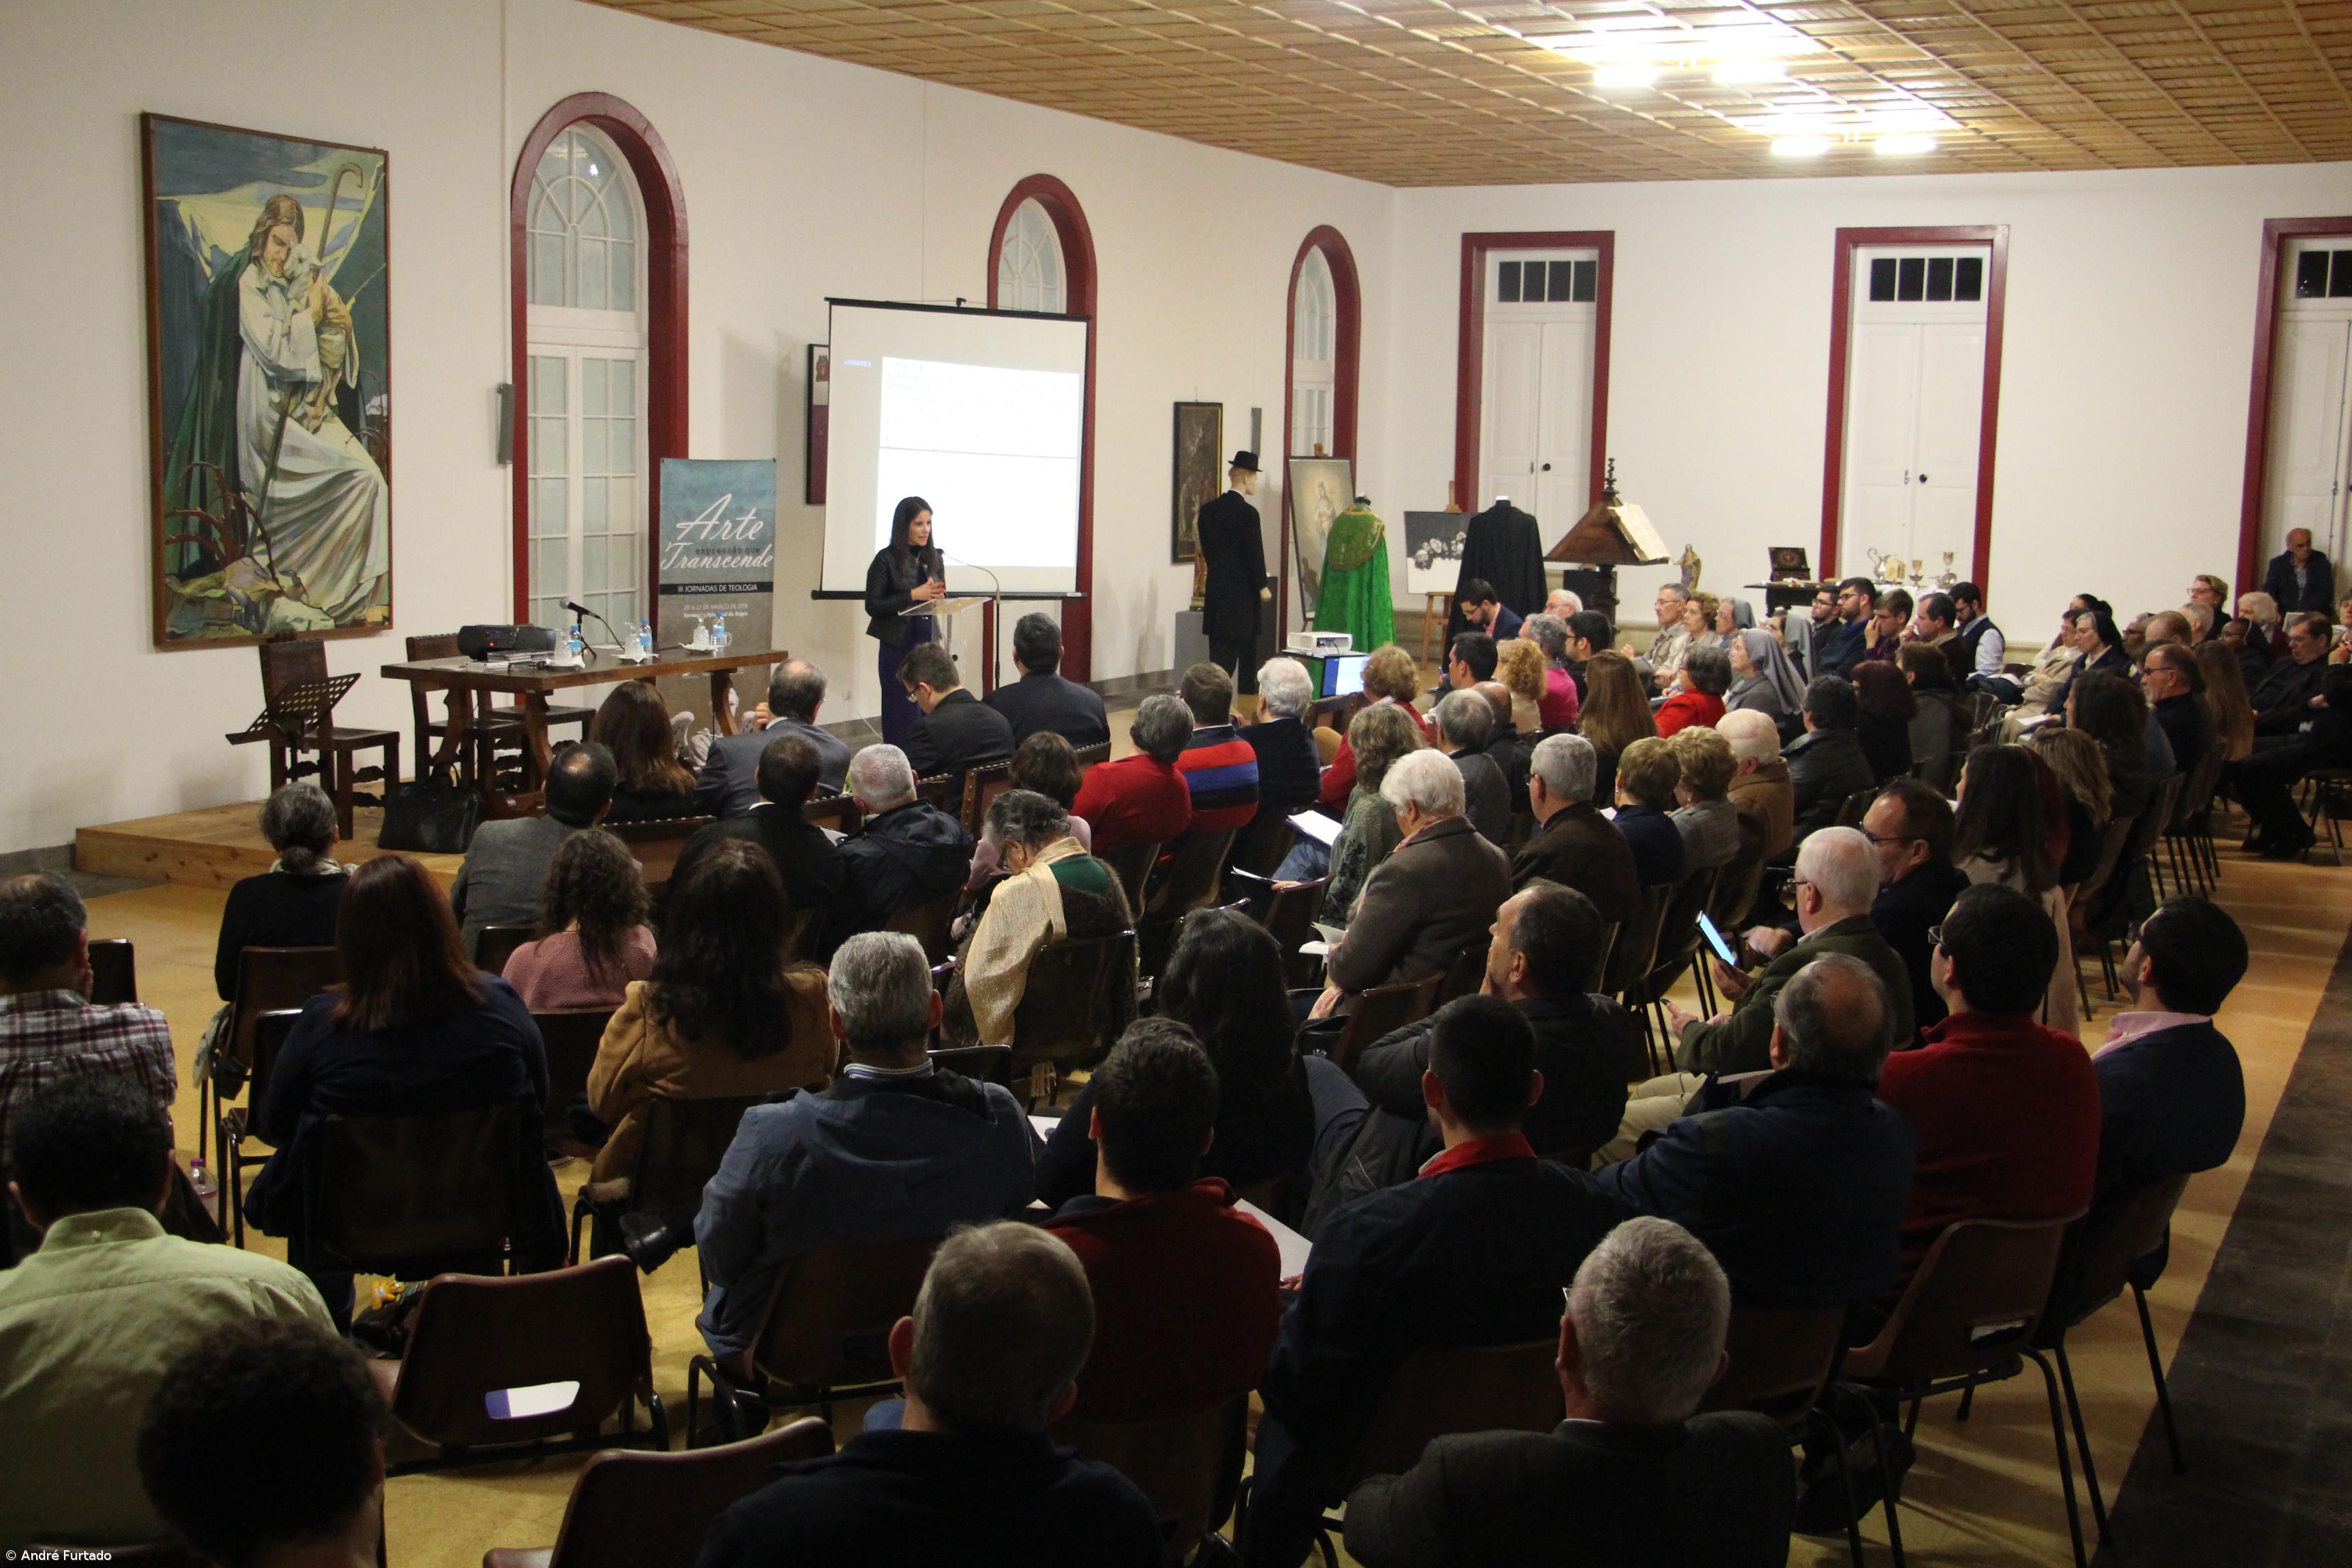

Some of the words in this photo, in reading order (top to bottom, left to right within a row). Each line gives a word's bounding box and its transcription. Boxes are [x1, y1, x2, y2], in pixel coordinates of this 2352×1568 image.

[676, 493, 764, 540] Arte
[661, 542, 773, 570] Transcende
[696, 546, 742, 557] expressão
[745, 546, 760, 556] que
[685, 585, 717, 593] JORNADAS
